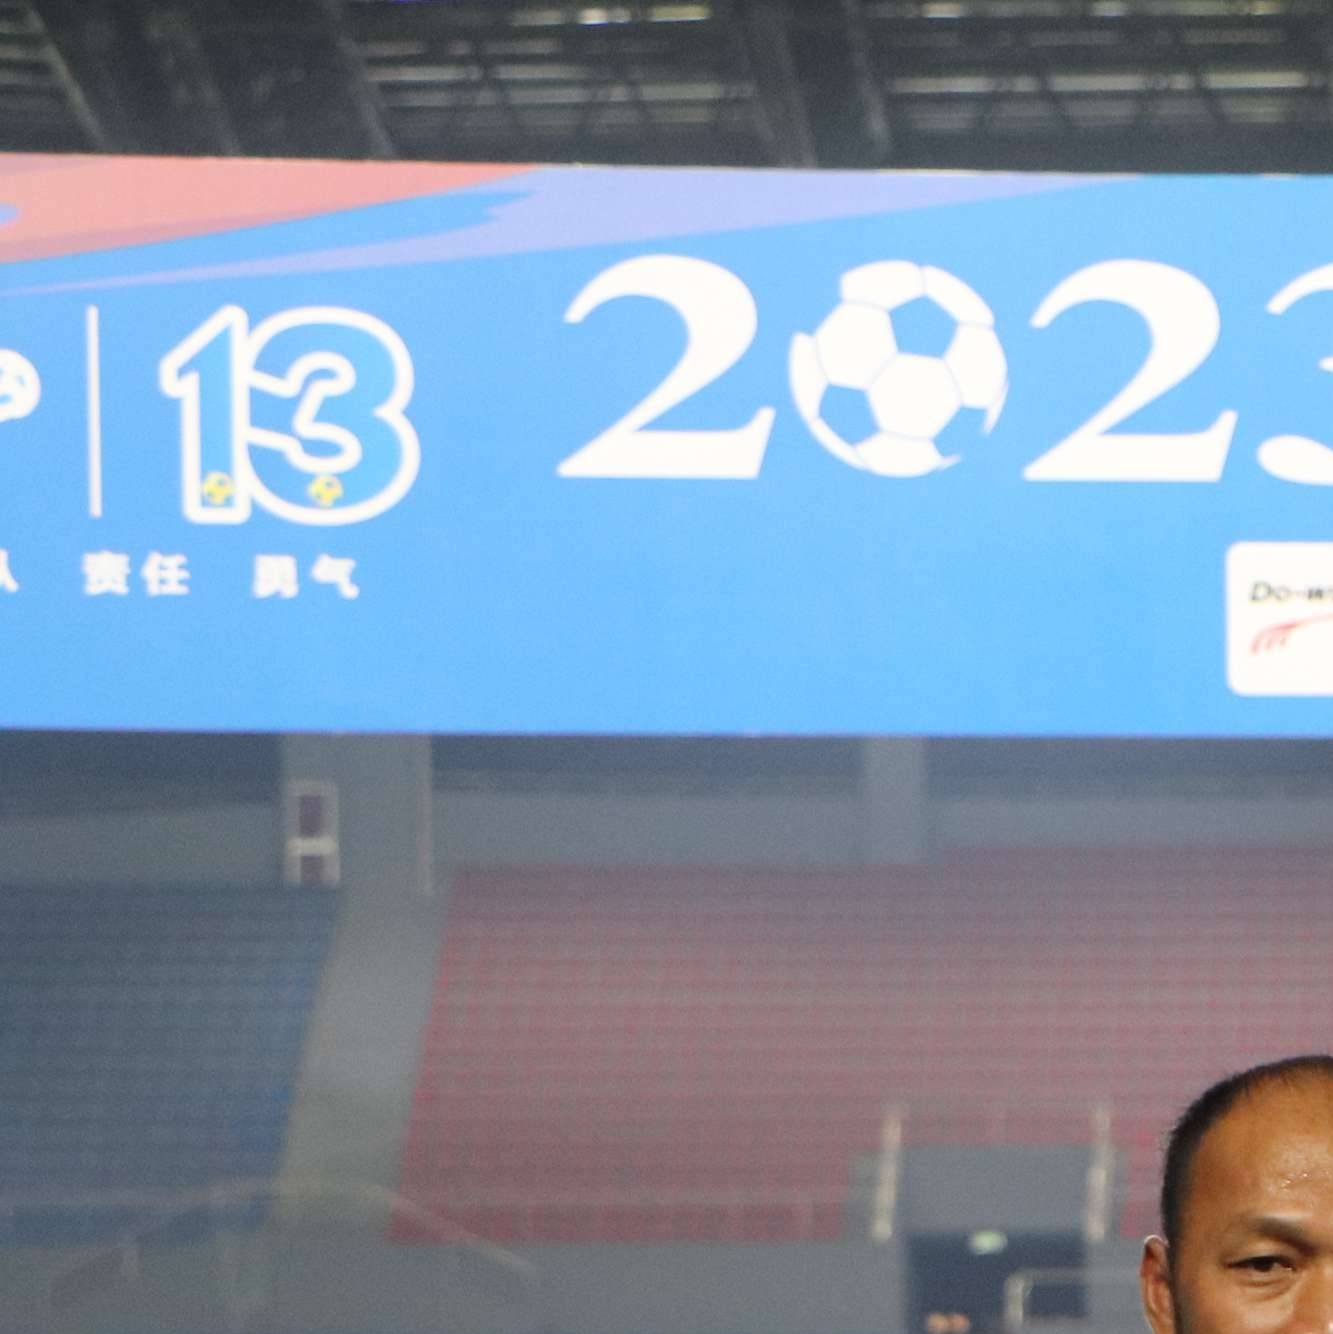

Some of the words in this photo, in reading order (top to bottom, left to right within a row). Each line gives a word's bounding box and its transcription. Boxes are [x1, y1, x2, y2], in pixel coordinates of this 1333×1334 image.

[159, 304, 421, 526] 13
[80, 550, 190, 597] 责任
[252, 553, 359, 600] 勇气
